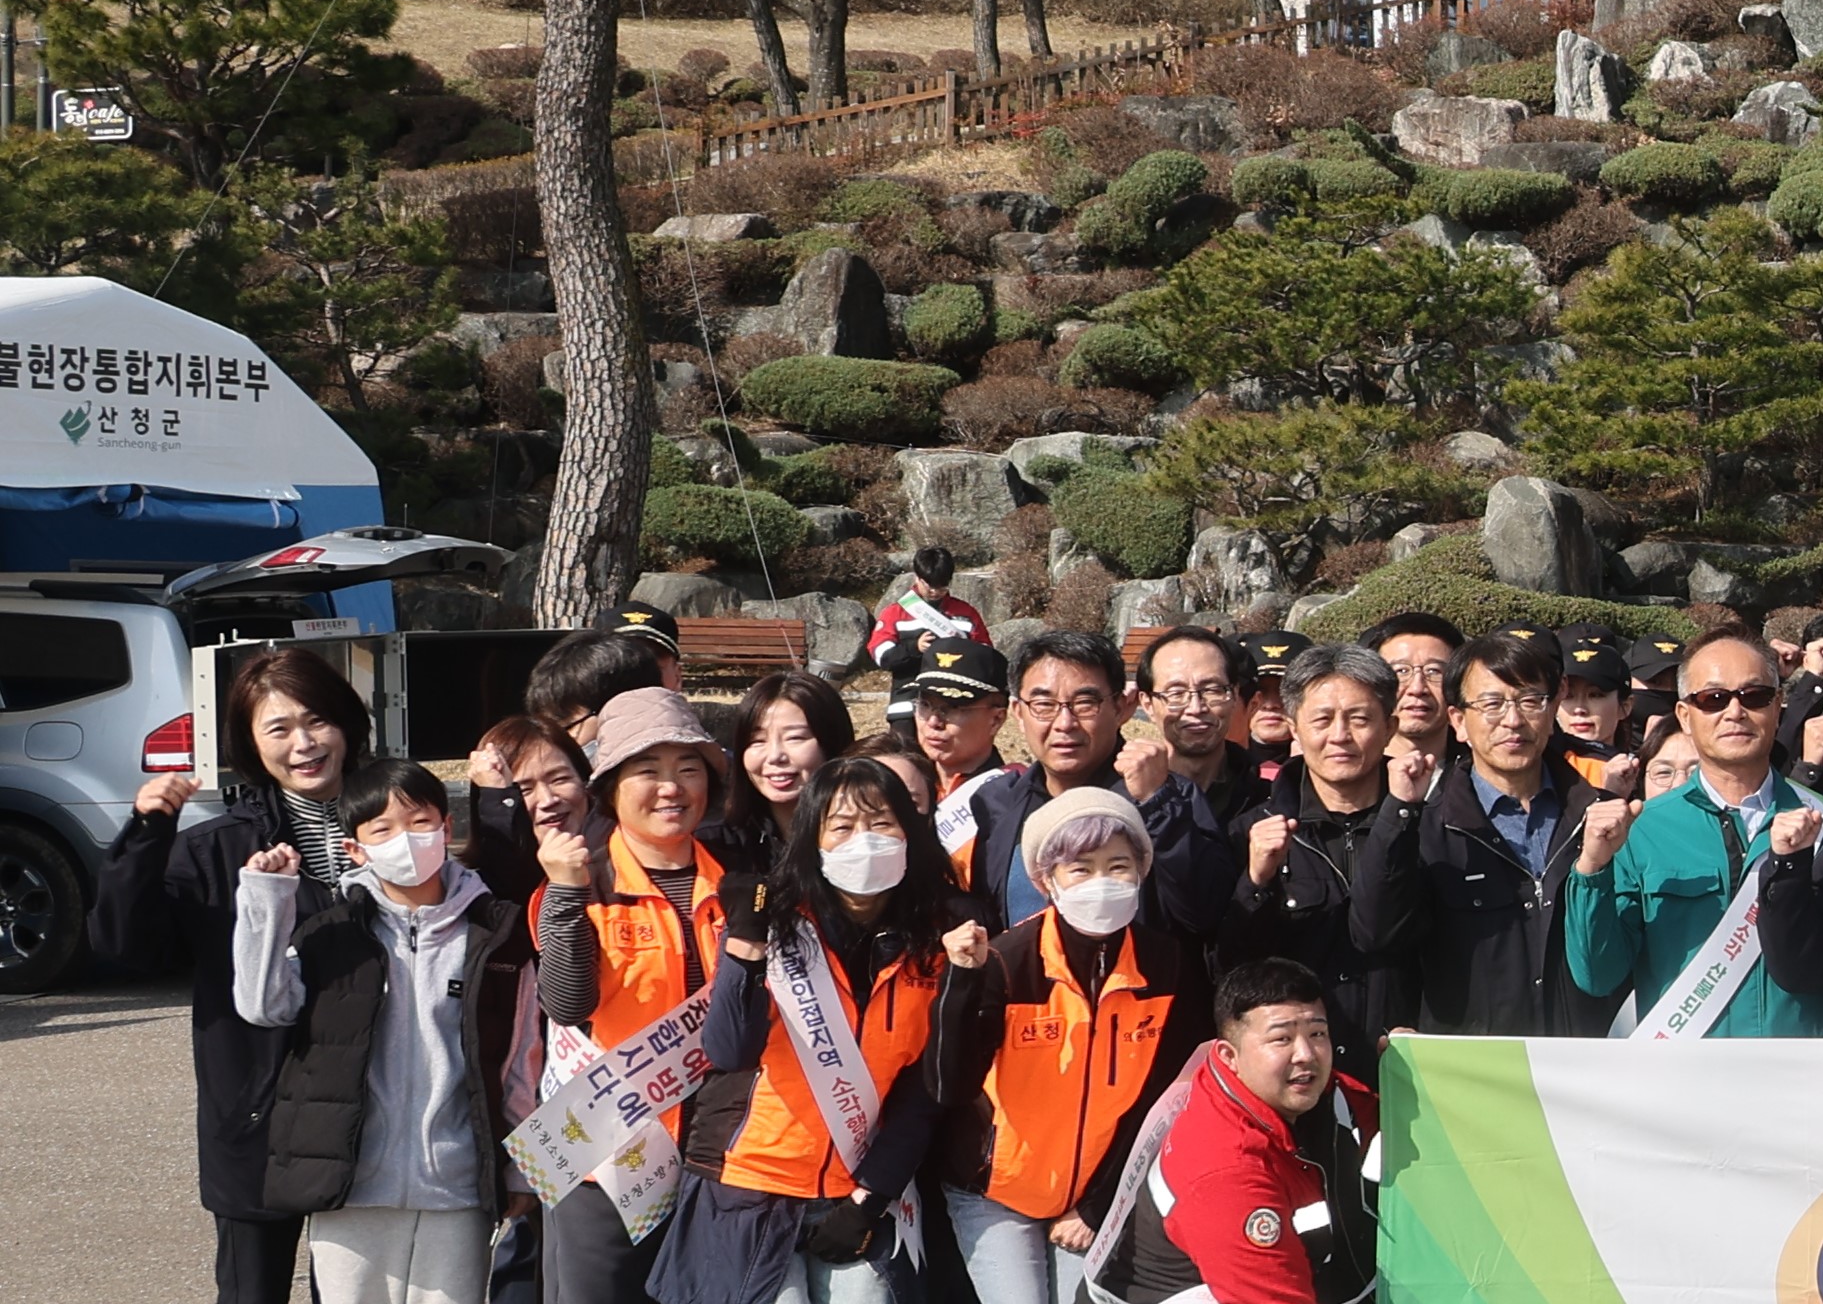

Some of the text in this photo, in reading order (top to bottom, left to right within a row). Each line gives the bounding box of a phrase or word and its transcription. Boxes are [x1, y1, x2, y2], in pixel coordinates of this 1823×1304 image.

[0, 343, 270, 402] 불현장통합지휘본부
[98, 406, 181, 436] 산청군
[97, 436, 182, 452] Sancheong-gun
[618, 924, 654, 945] 산청
[1667, 898, 1761, 1034] 밭소각 산불되어
[1020, 1022, 1059, 1043] 산청
[529, 1118, 579, 1185] 산청소방서
[618, 1153, 679, 1208] 산청소방서
